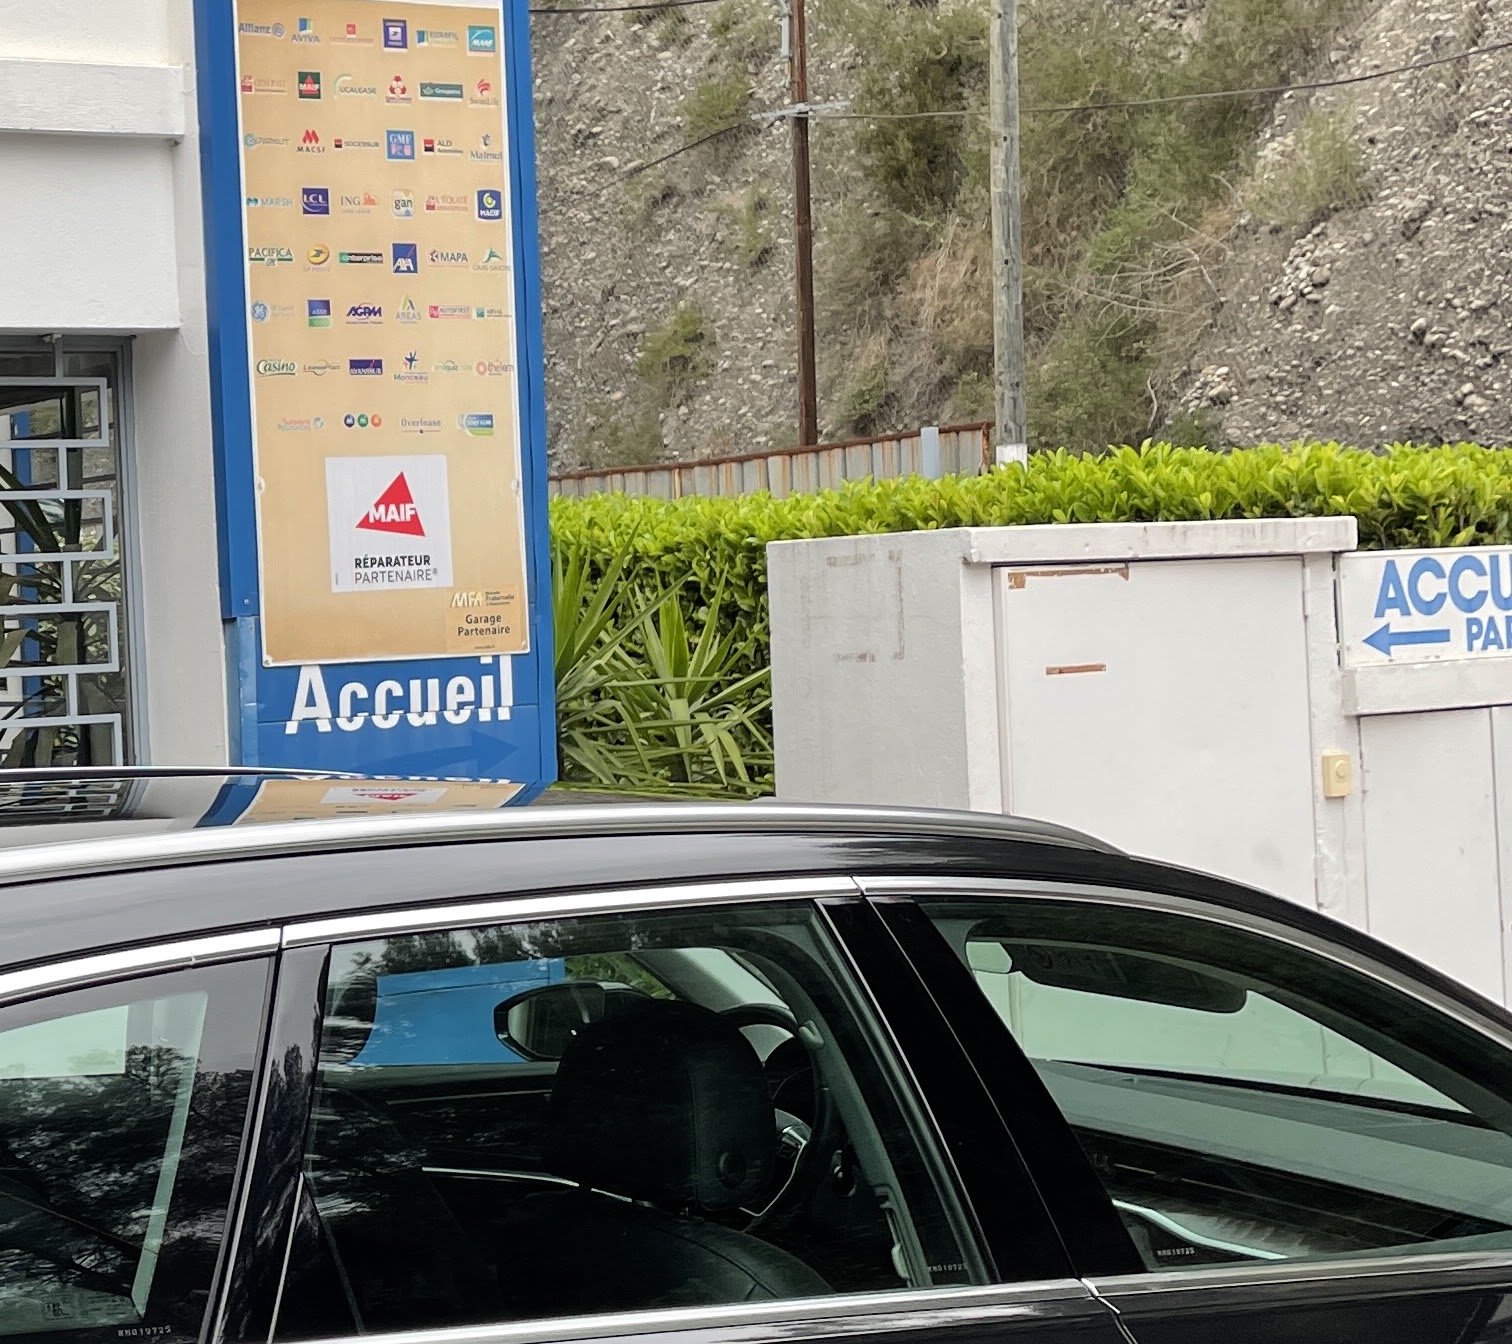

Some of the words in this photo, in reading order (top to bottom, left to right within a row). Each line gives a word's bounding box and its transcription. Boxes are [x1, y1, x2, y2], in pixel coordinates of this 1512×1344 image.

[340, 196, 361, 206] ING
[393, 198, 413, 211] gan
[248, 247, 293, 257] PACIFICA
[440, 251, 469, 263] MAPA
[393, 257, 415, 271] AXA
[256, 359, 297, 376] Casino
[368, 503, 418, 524] MAIF
[354, 554, 431, 569] RÉPARATEUR
[465, 613, 502, 626] Garage
[457, 625, 511, 637] Partenaire
[285, 655, 514, 735] Accueil
